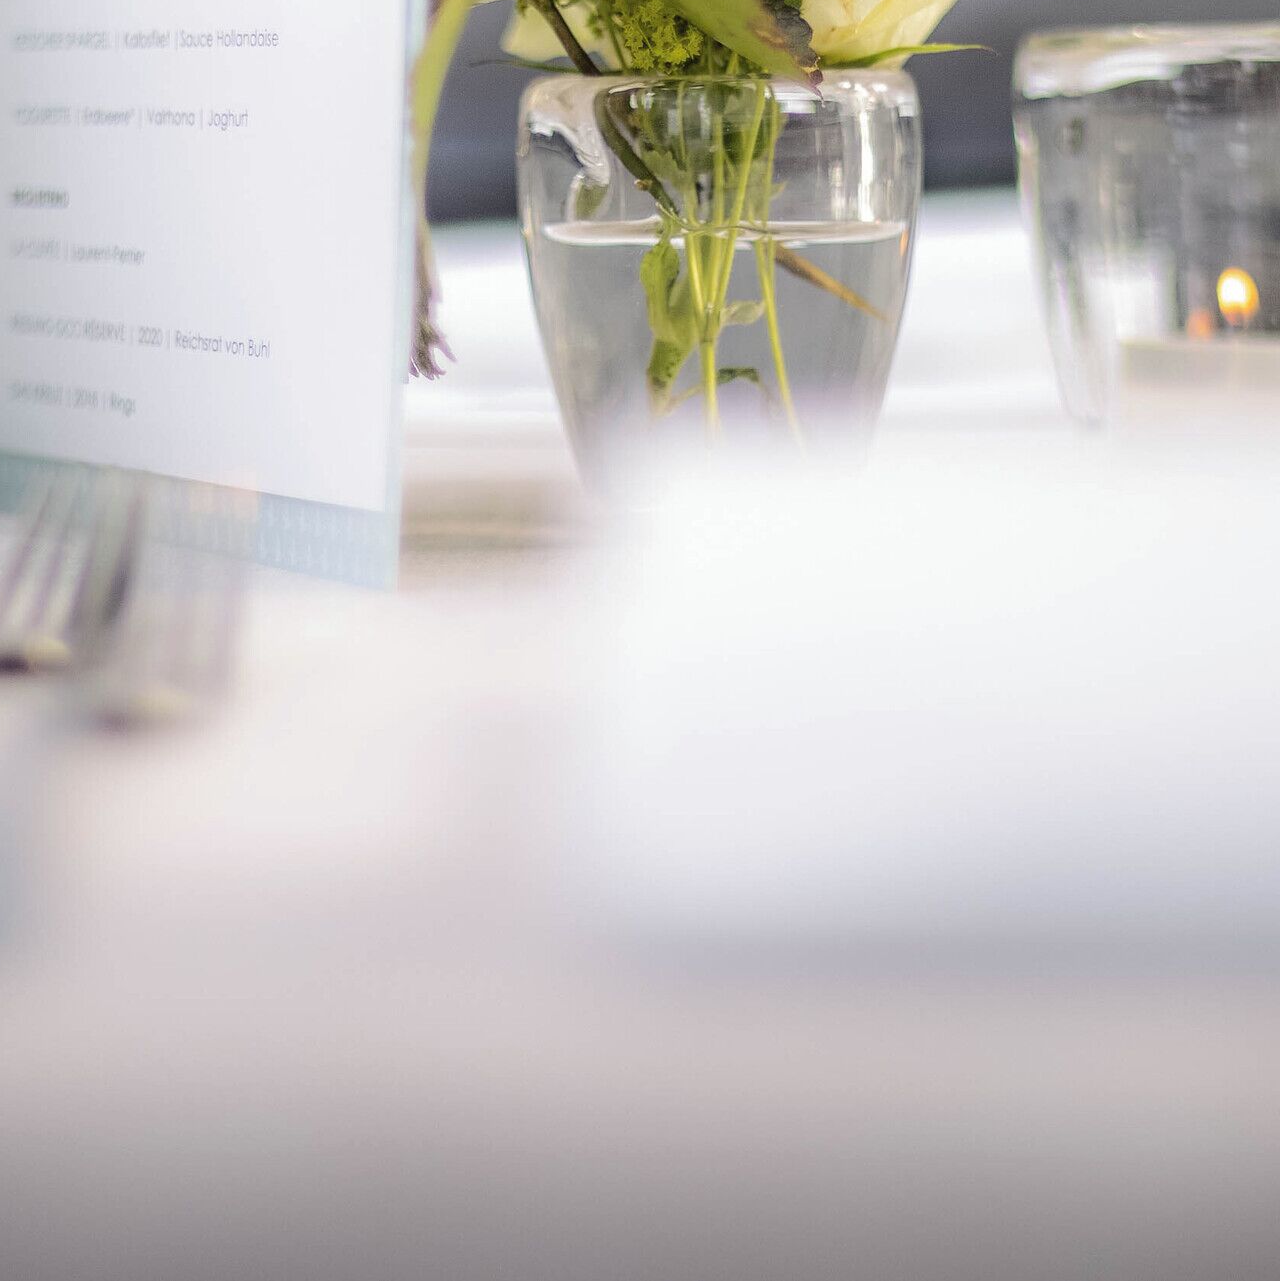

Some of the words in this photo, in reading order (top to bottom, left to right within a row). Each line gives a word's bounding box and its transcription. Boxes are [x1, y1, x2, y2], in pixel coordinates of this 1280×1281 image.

[217, 26, 280, 48] Hollandaise
[208, 106, 248, 131] Joghurt
[138, 325, 164, 348] 2020
[175, 329, 222, 354] Reichsrat
[224, 335, 245, 356] von
[247, 335, 272, 360] Buhl
